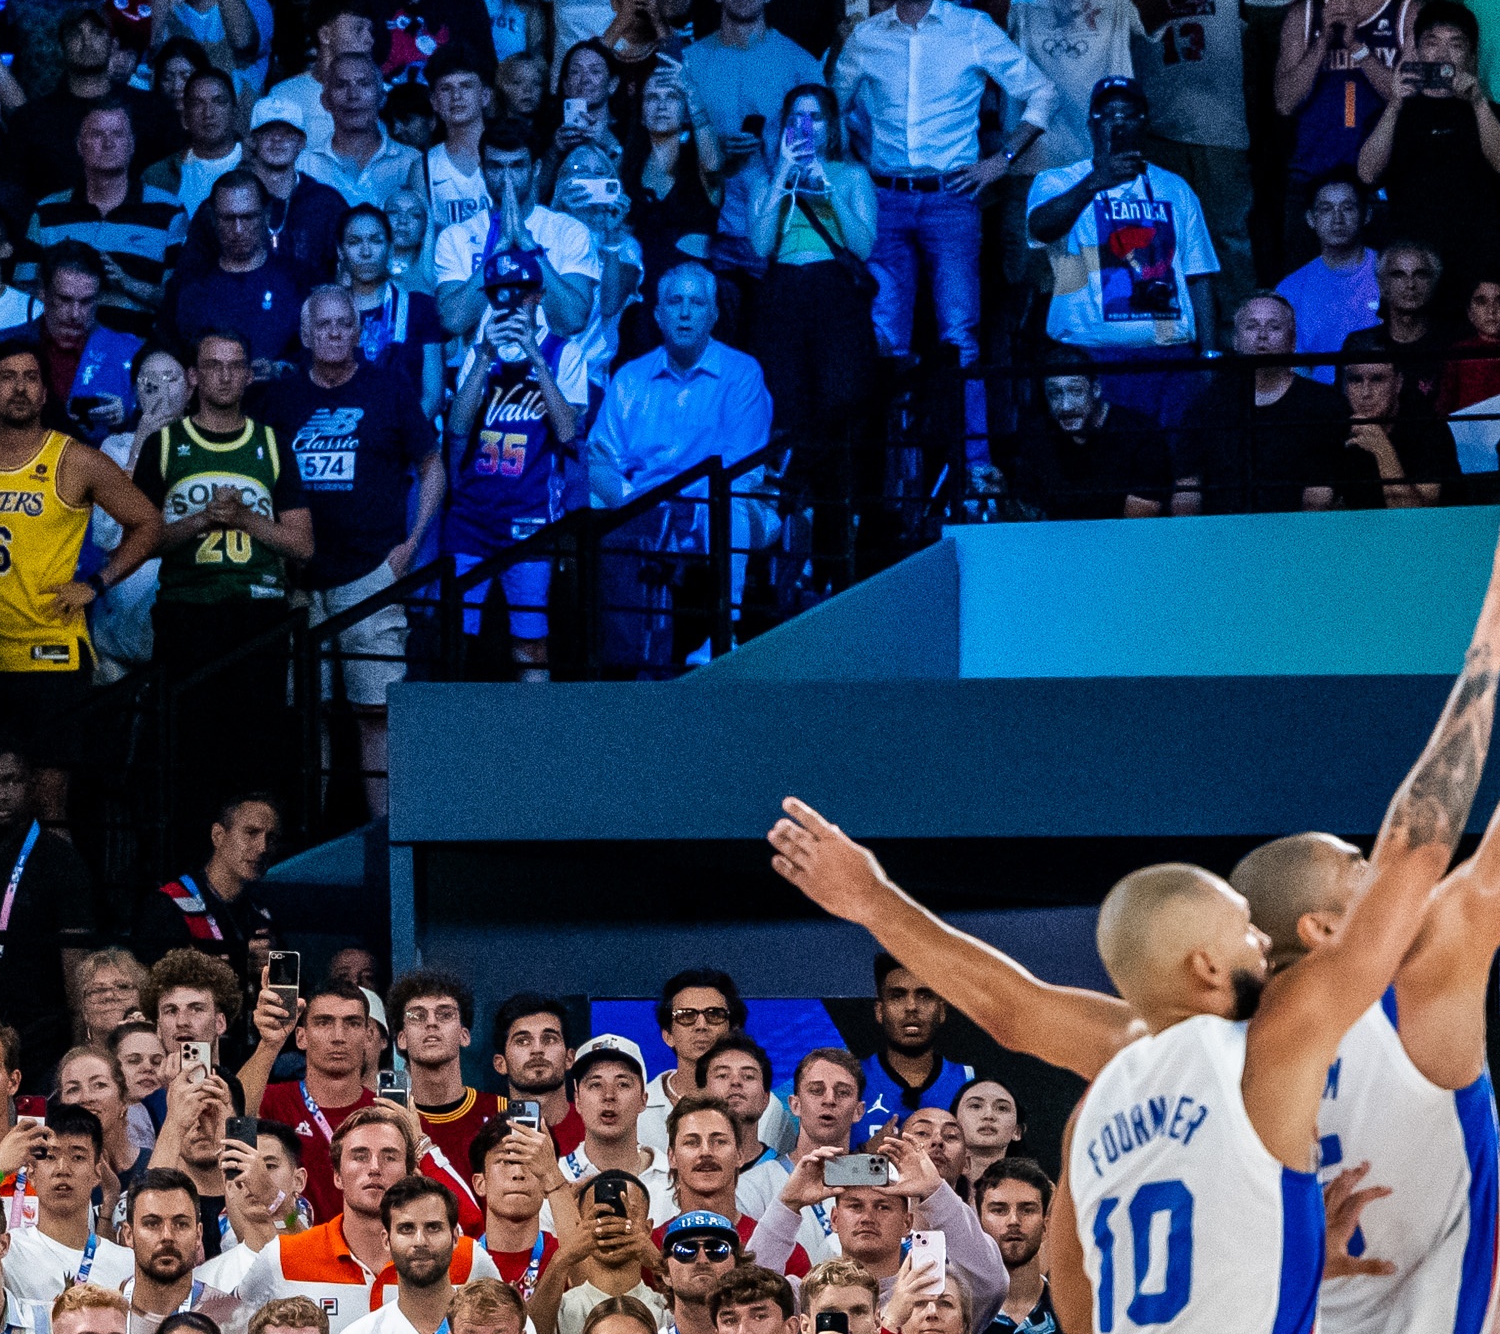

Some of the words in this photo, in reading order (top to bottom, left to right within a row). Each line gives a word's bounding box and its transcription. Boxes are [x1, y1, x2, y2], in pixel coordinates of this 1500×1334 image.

[1164, 20, 1201, 65] 13
[485, 383, 548, 427] Valle
[291, 432, 360, 451] Classic
[477, 429, 528, 477] 35
[304, 455, 343, 477] 574
[196, 530, 253, 564] 20
[1093, 1180, 1194, 1333] 10
